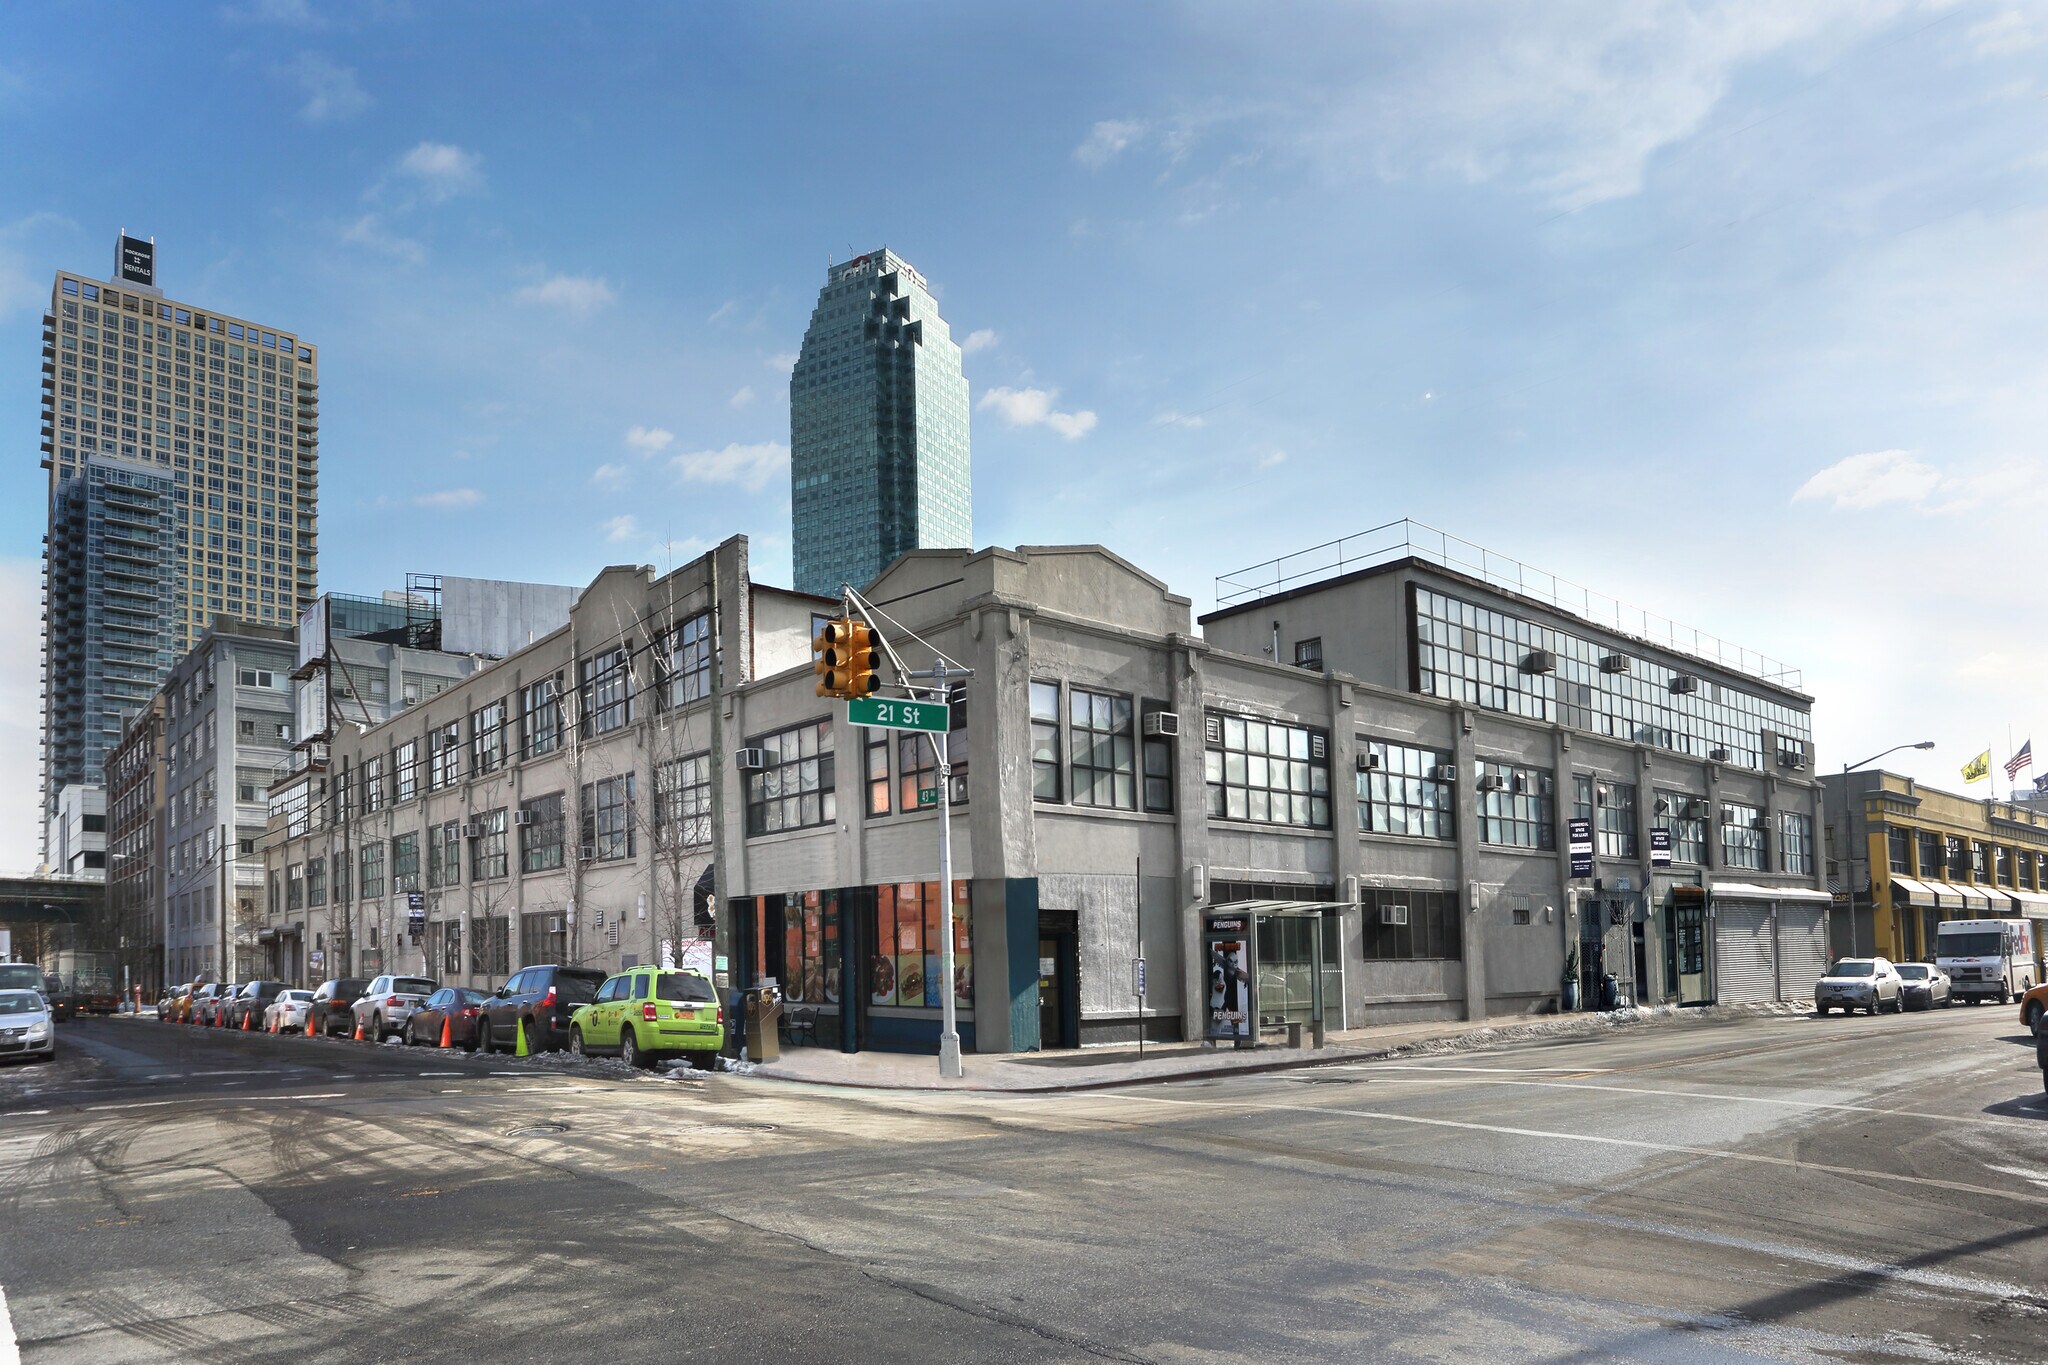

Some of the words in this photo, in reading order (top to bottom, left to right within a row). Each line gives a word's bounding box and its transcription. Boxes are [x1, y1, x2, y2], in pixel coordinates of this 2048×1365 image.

[124, 248, 151, 260] ROCKROSE
[124, 263, 151, 276] RENTALS
[877, 703, 894, 722] 21
[902, 706, 920, 725] St
[921, 790, 929, 803] 43
[1213, 920, 1242, 929] PENGUINS
[1213, 1010, 1248, 1020] PENGUINS
